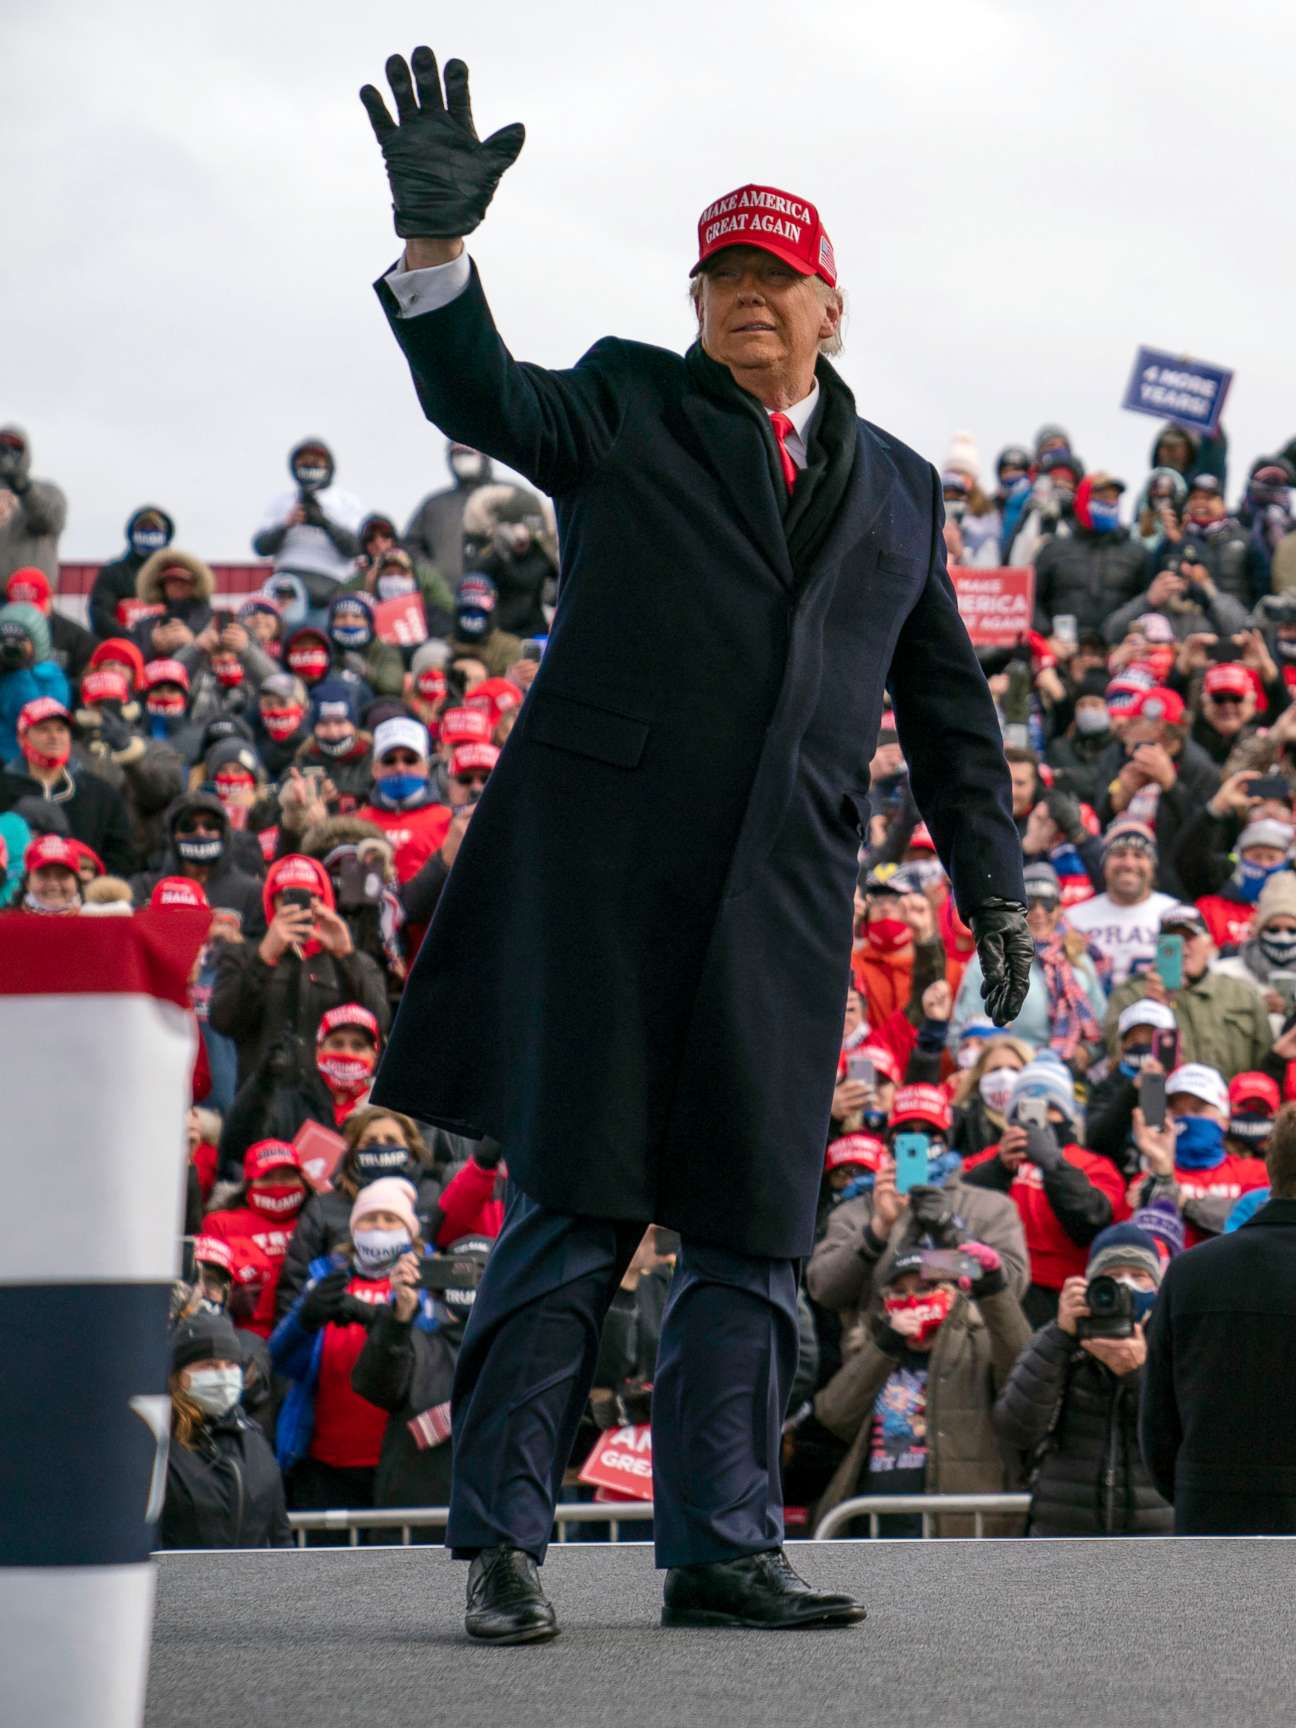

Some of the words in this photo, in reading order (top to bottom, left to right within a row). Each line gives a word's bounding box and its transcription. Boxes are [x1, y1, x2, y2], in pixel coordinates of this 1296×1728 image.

[701, 194, 738, 225] MAKE
[738, 190, 812, 225] AMERICA
[705, 213, 750, 245] GREAT
[749, 213, 802, 244] AGAIN
[1142, 365, 1160, 382] 4
[1159, 370, 1218, 400] MORE
[178, 842, 222, 857] TRUMP
[1092, 924, 1161, 945] PRAY
[358, 1152, 409, 1168] TRUMP
[252, 1191, 304, 1212] TRUMP
[445, 1288, 476, 1306] TRUM
[601, 1449, 652, 1477] GRE
